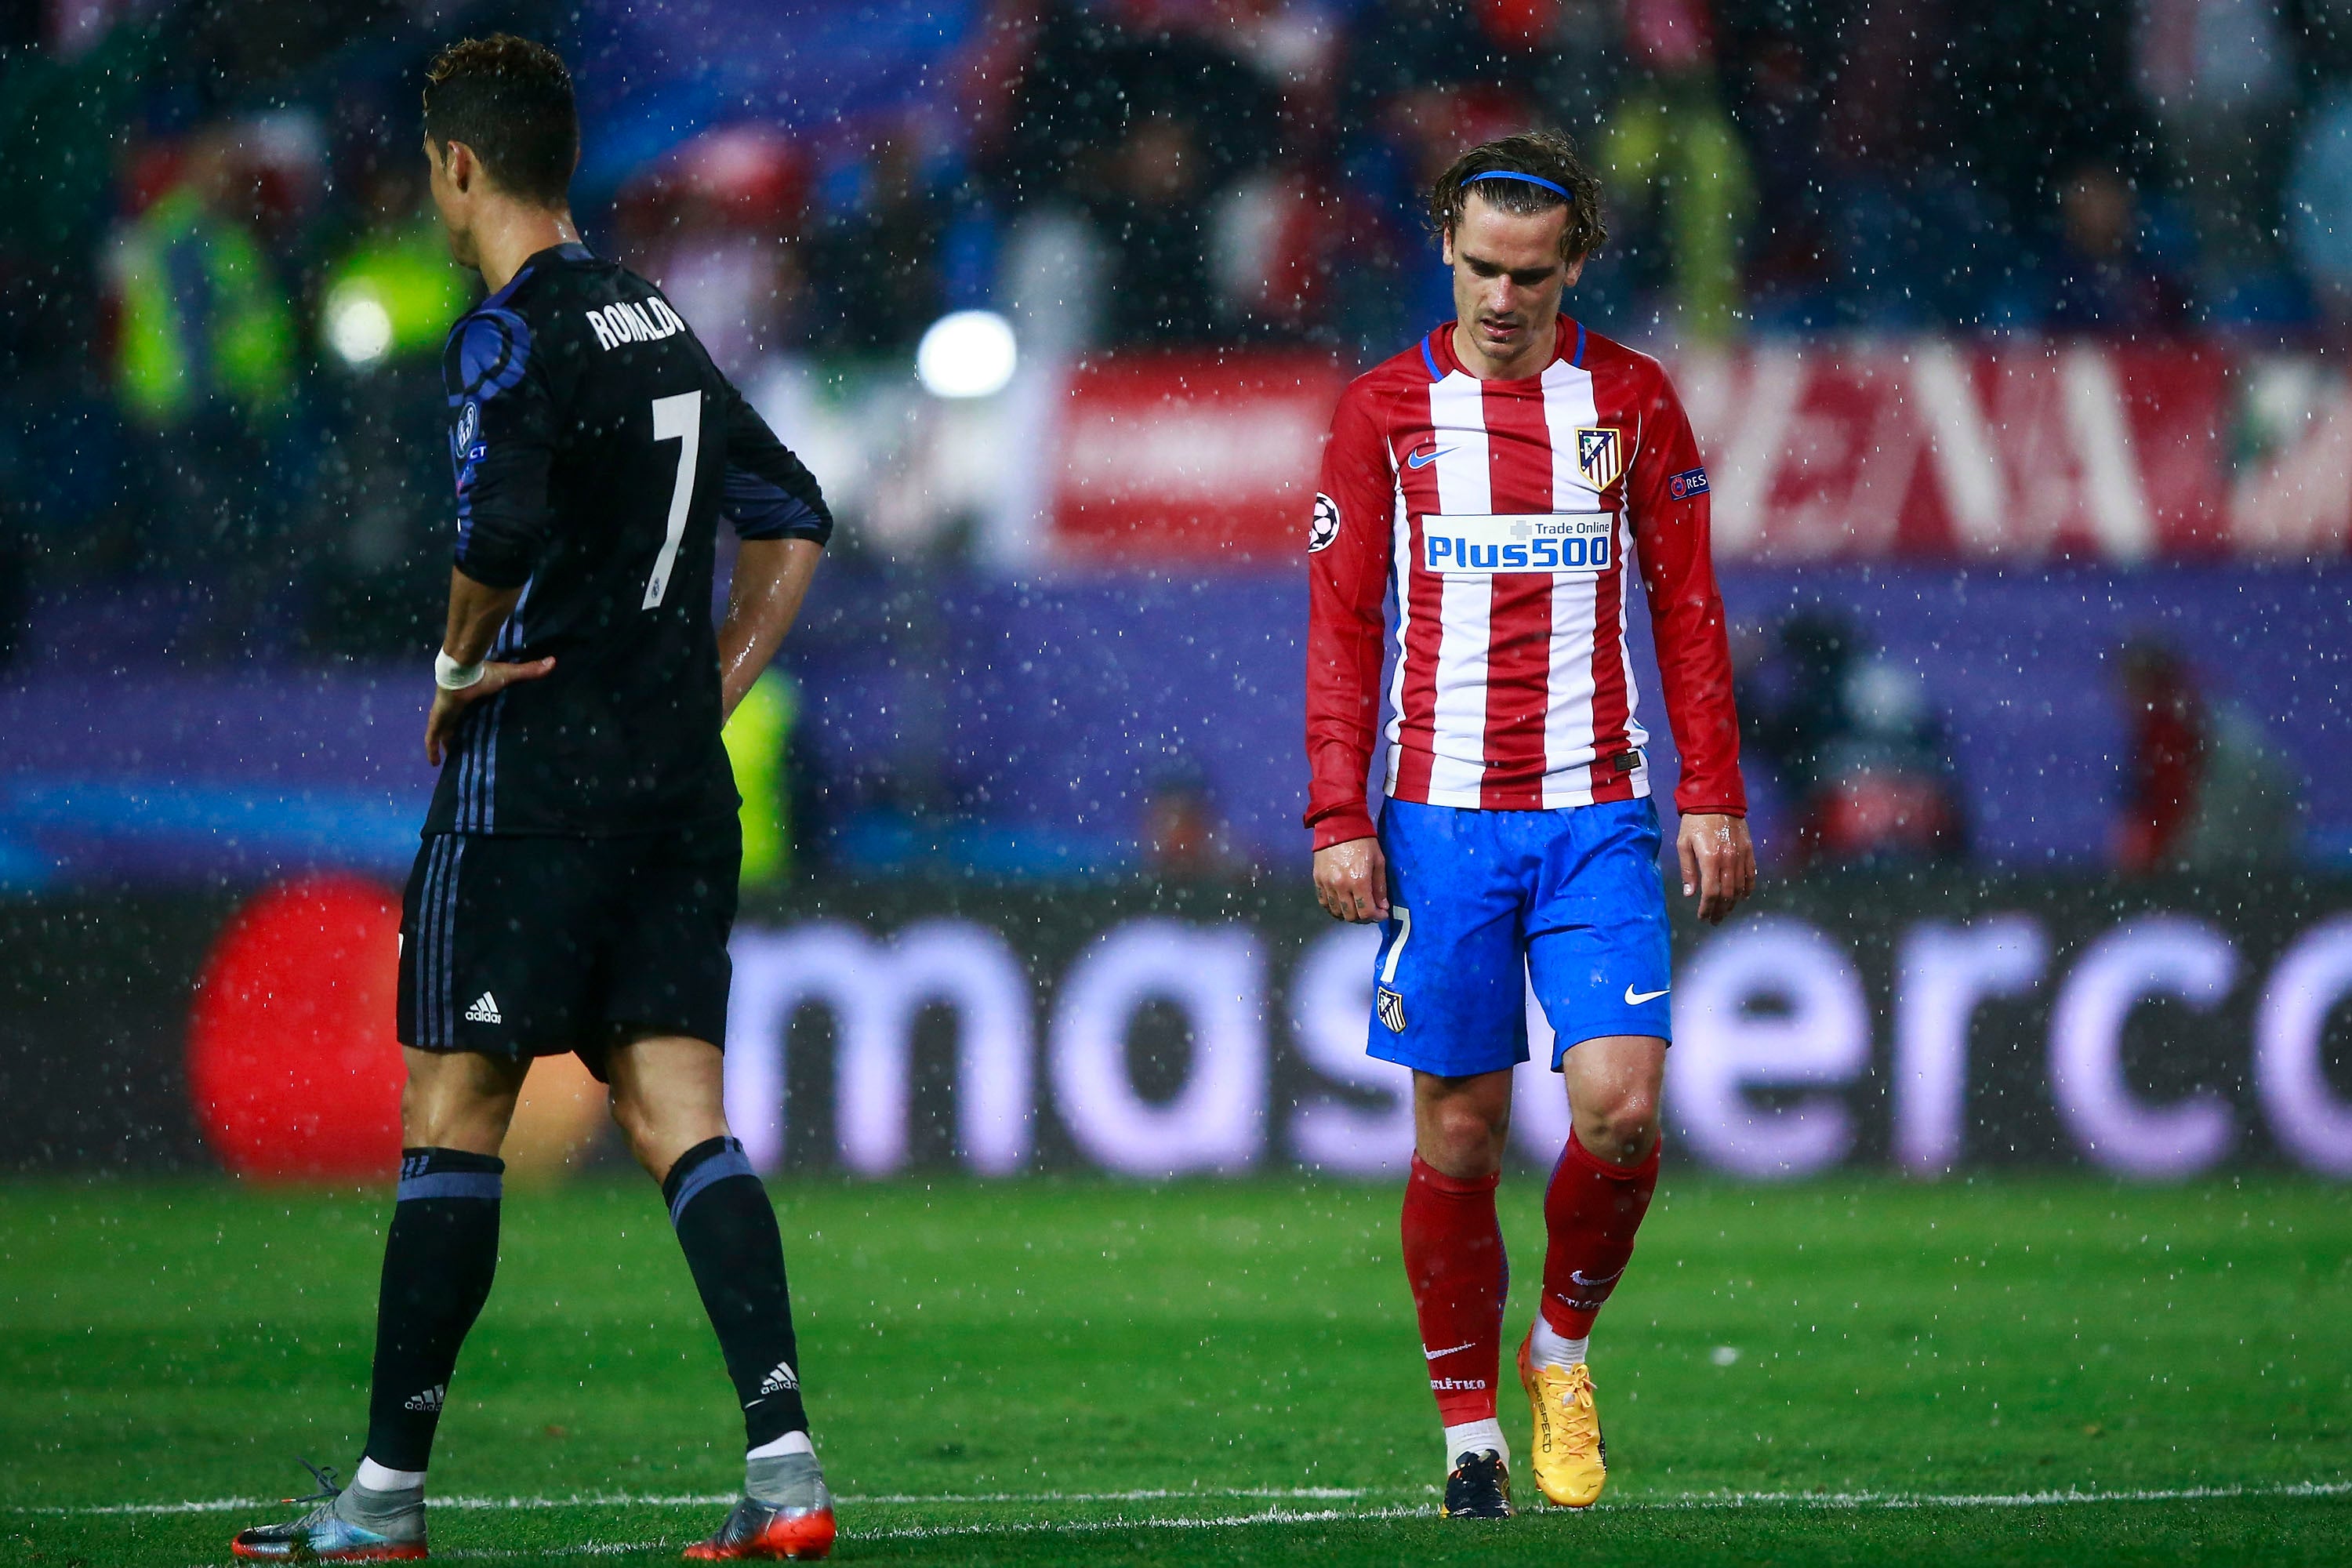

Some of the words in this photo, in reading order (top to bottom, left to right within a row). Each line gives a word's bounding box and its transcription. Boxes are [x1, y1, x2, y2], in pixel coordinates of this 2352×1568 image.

[1686, 474, 1707, 489] RES
[642, 390, 702, 611] 7
[1535, 523, 1573, 534] Trade
[1577, 522, 1610, 533] Online
[1428, 536, 1608, 567] Plus500
[1380, 905, 1411, 983] 7
[465, 1011, 502, 1025] adidas
